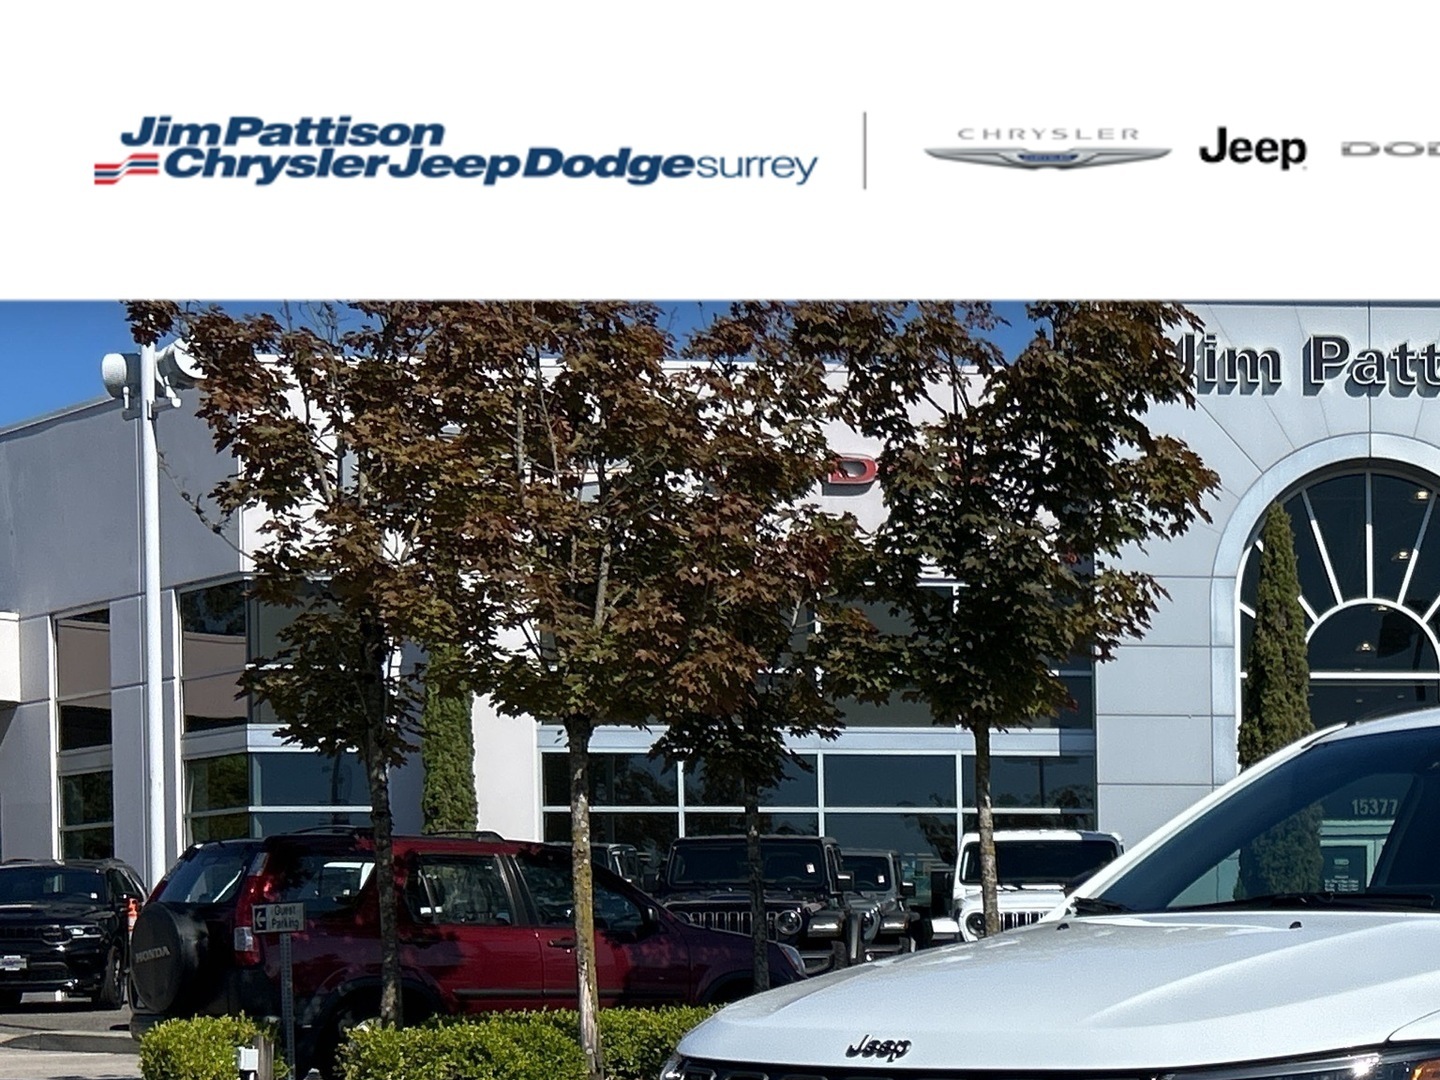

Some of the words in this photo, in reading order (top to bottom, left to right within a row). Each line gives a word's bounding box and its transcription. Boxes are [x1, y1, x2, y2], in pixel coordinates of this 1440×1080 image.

[1176, 333, 1283, 385] Jim
[1351, 799, 1399, 816] 15377
[273, 904, 297, 917] Guest
[271, 917, 300, 930] Parking
[134, 945, 171, 964] HONDA
[845, 1034, 912, 1063] Jeep
